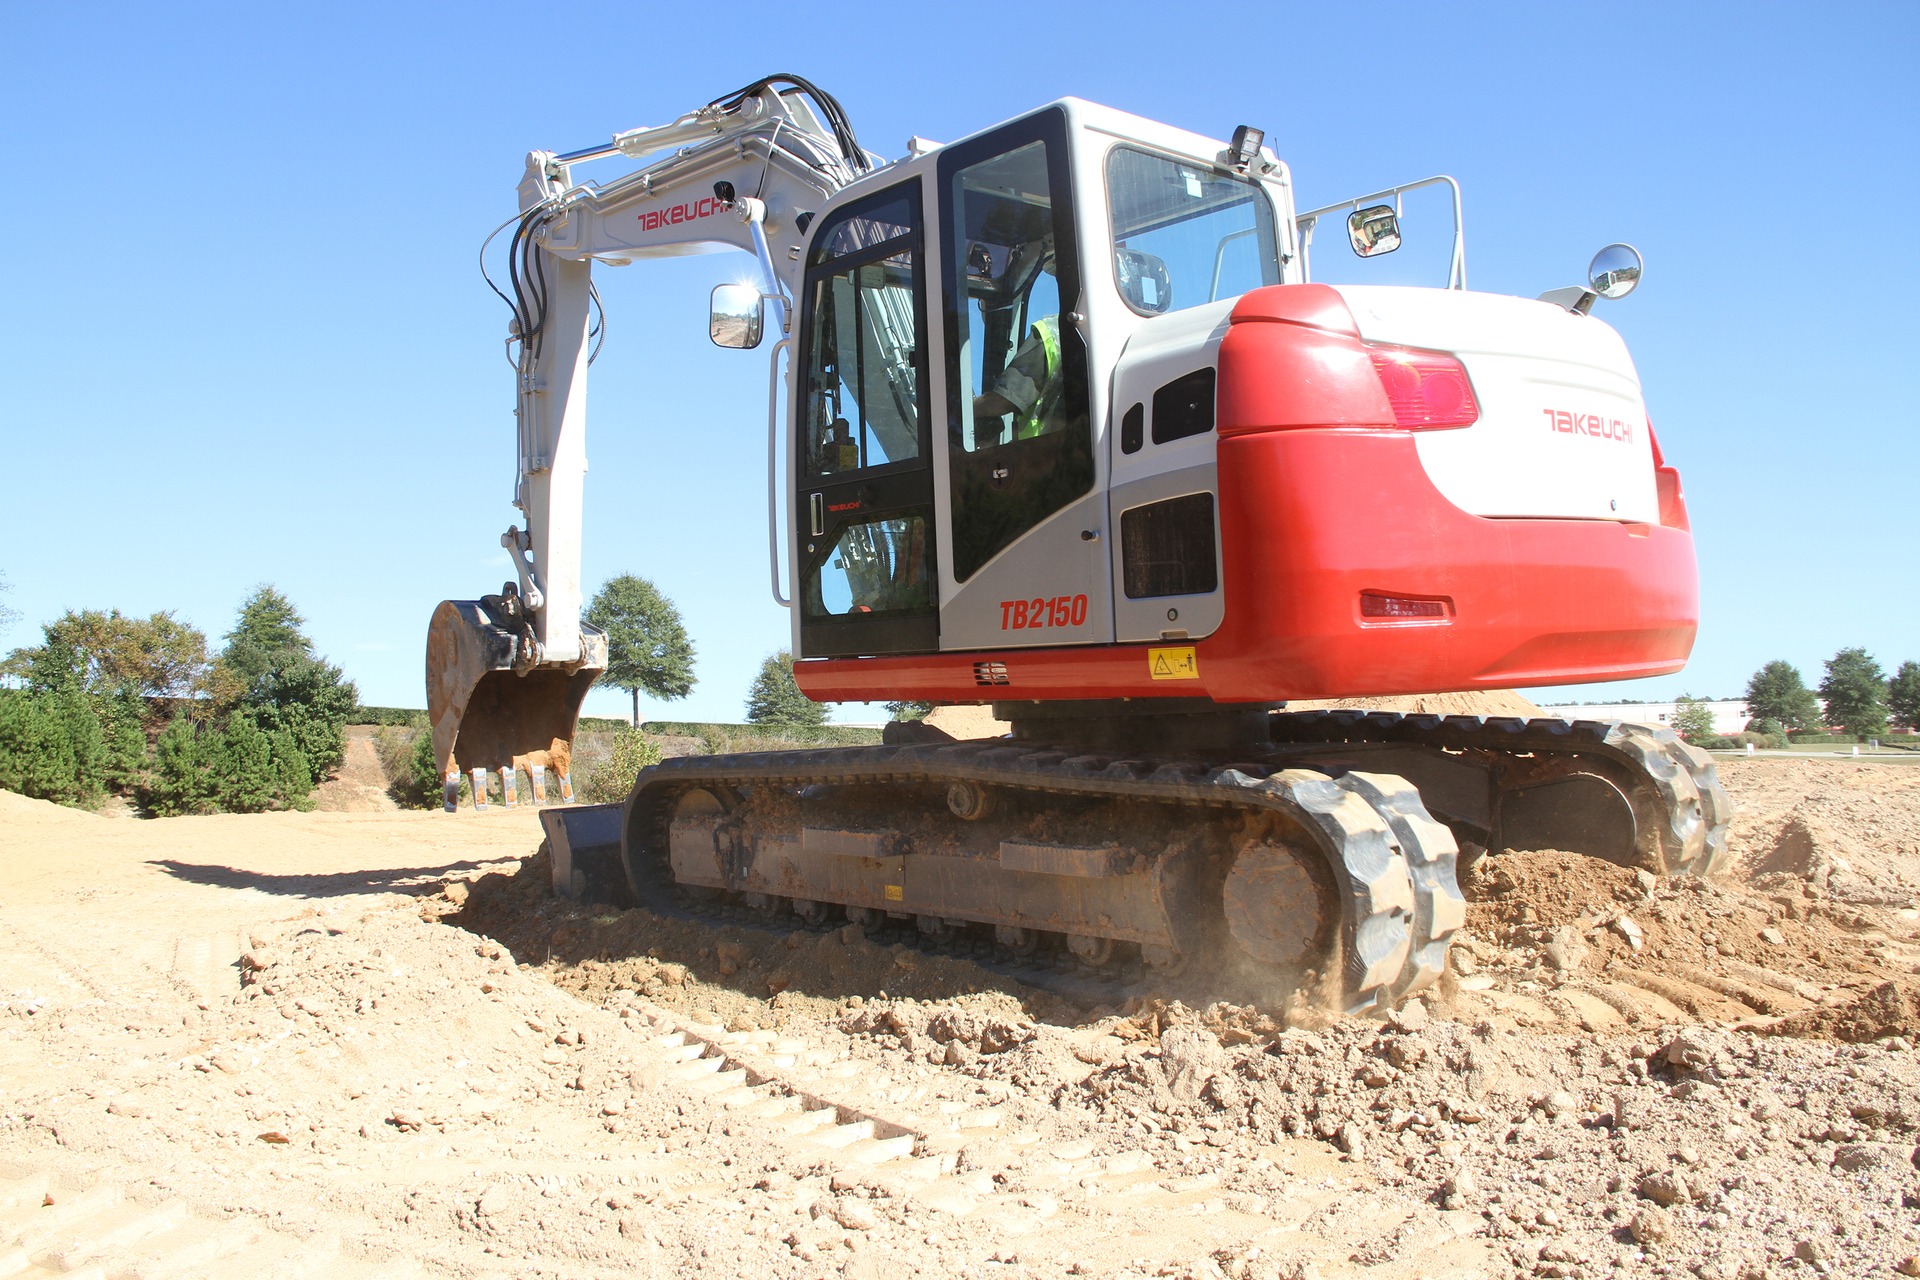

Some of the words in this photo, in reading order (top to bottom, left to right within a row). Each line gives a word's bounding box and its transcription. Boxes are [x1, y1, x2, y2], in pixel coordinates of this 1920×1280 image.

[638, 197, 728, 231] TAKEUCH
[1543, 408, 1633, 444] TAKEUCHI
[1000, 594, 1088, 630] TB2150
